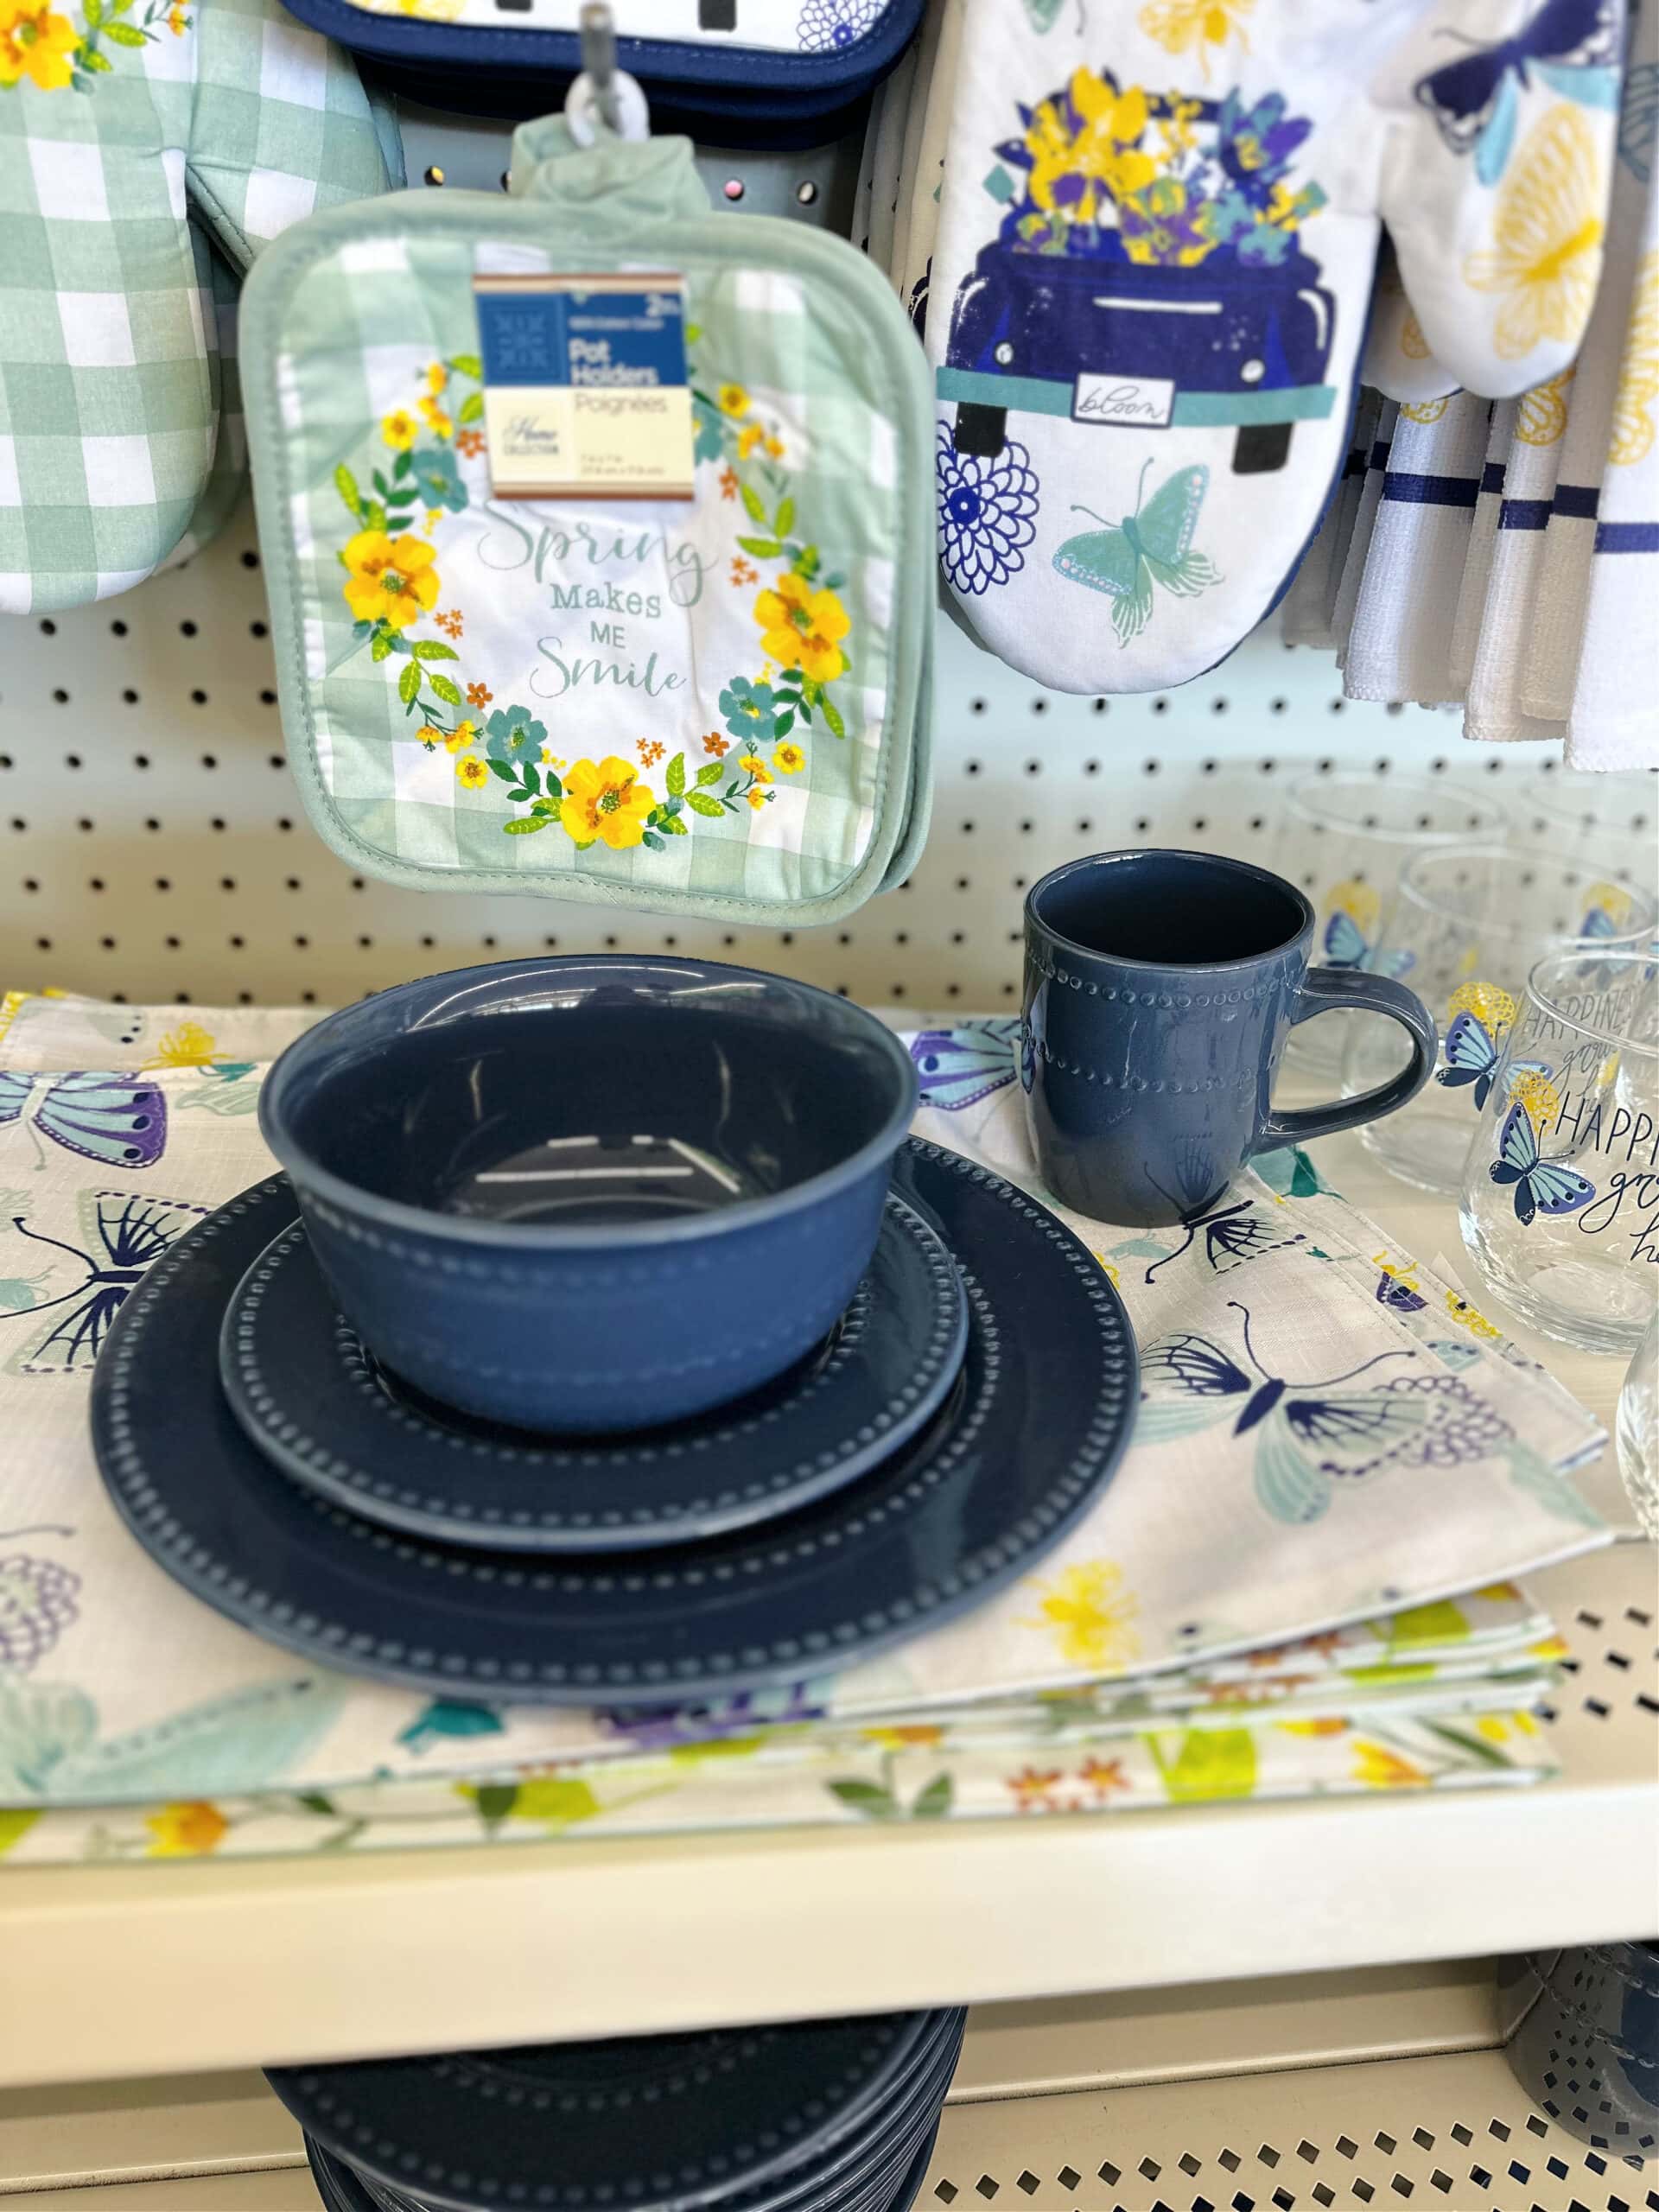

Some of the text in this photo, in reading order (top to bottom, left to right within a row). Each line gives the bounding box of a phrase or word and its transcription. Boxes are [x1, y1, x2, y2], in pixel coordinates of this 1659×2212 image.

[568, 338, 611, 363] Pot
[570, 362, 659, 387] Holders
[1077, 385, 1167, 420] bloom
[477, 498, 720, 607] Spring
[550, 581, 663, 619] Makes
[589, 620, 626, 650] ME
[529, 636, 688, 698] Smile
